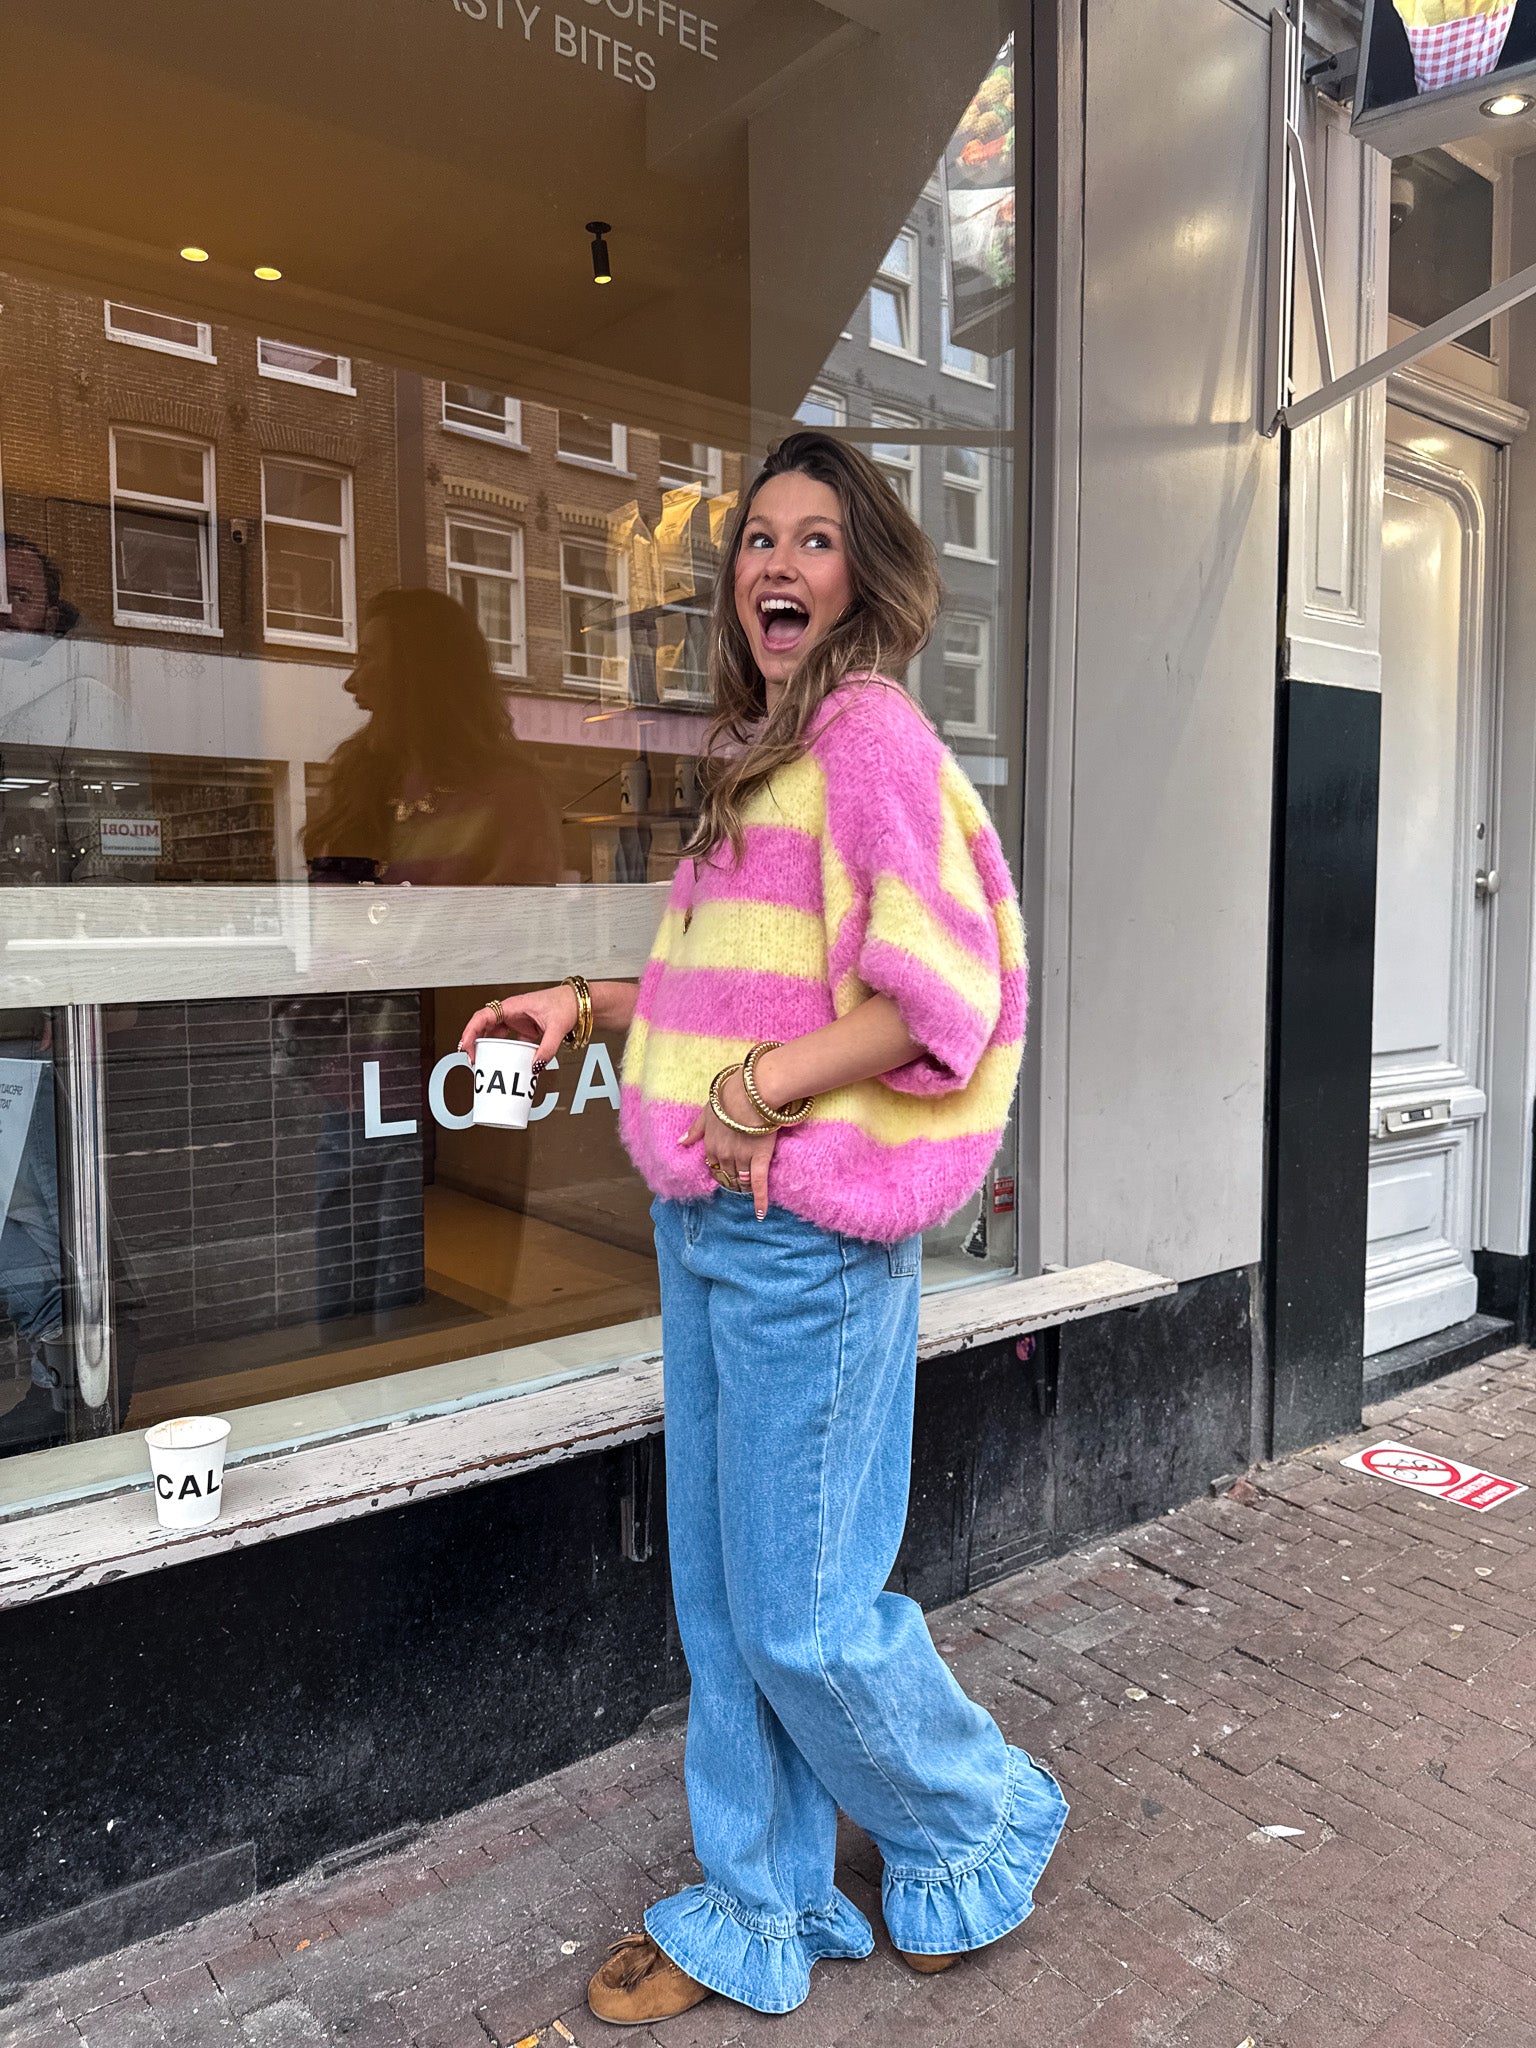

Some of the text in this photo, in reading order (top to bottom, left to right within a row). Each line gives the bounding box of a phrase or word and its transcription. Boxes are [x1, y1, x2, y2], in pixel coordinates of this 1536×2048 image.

[453, 0, 656, 91] STY BITES
[583, 0, 718, 61] OFFEE
[156, 1469, 224, 1500] CAL
